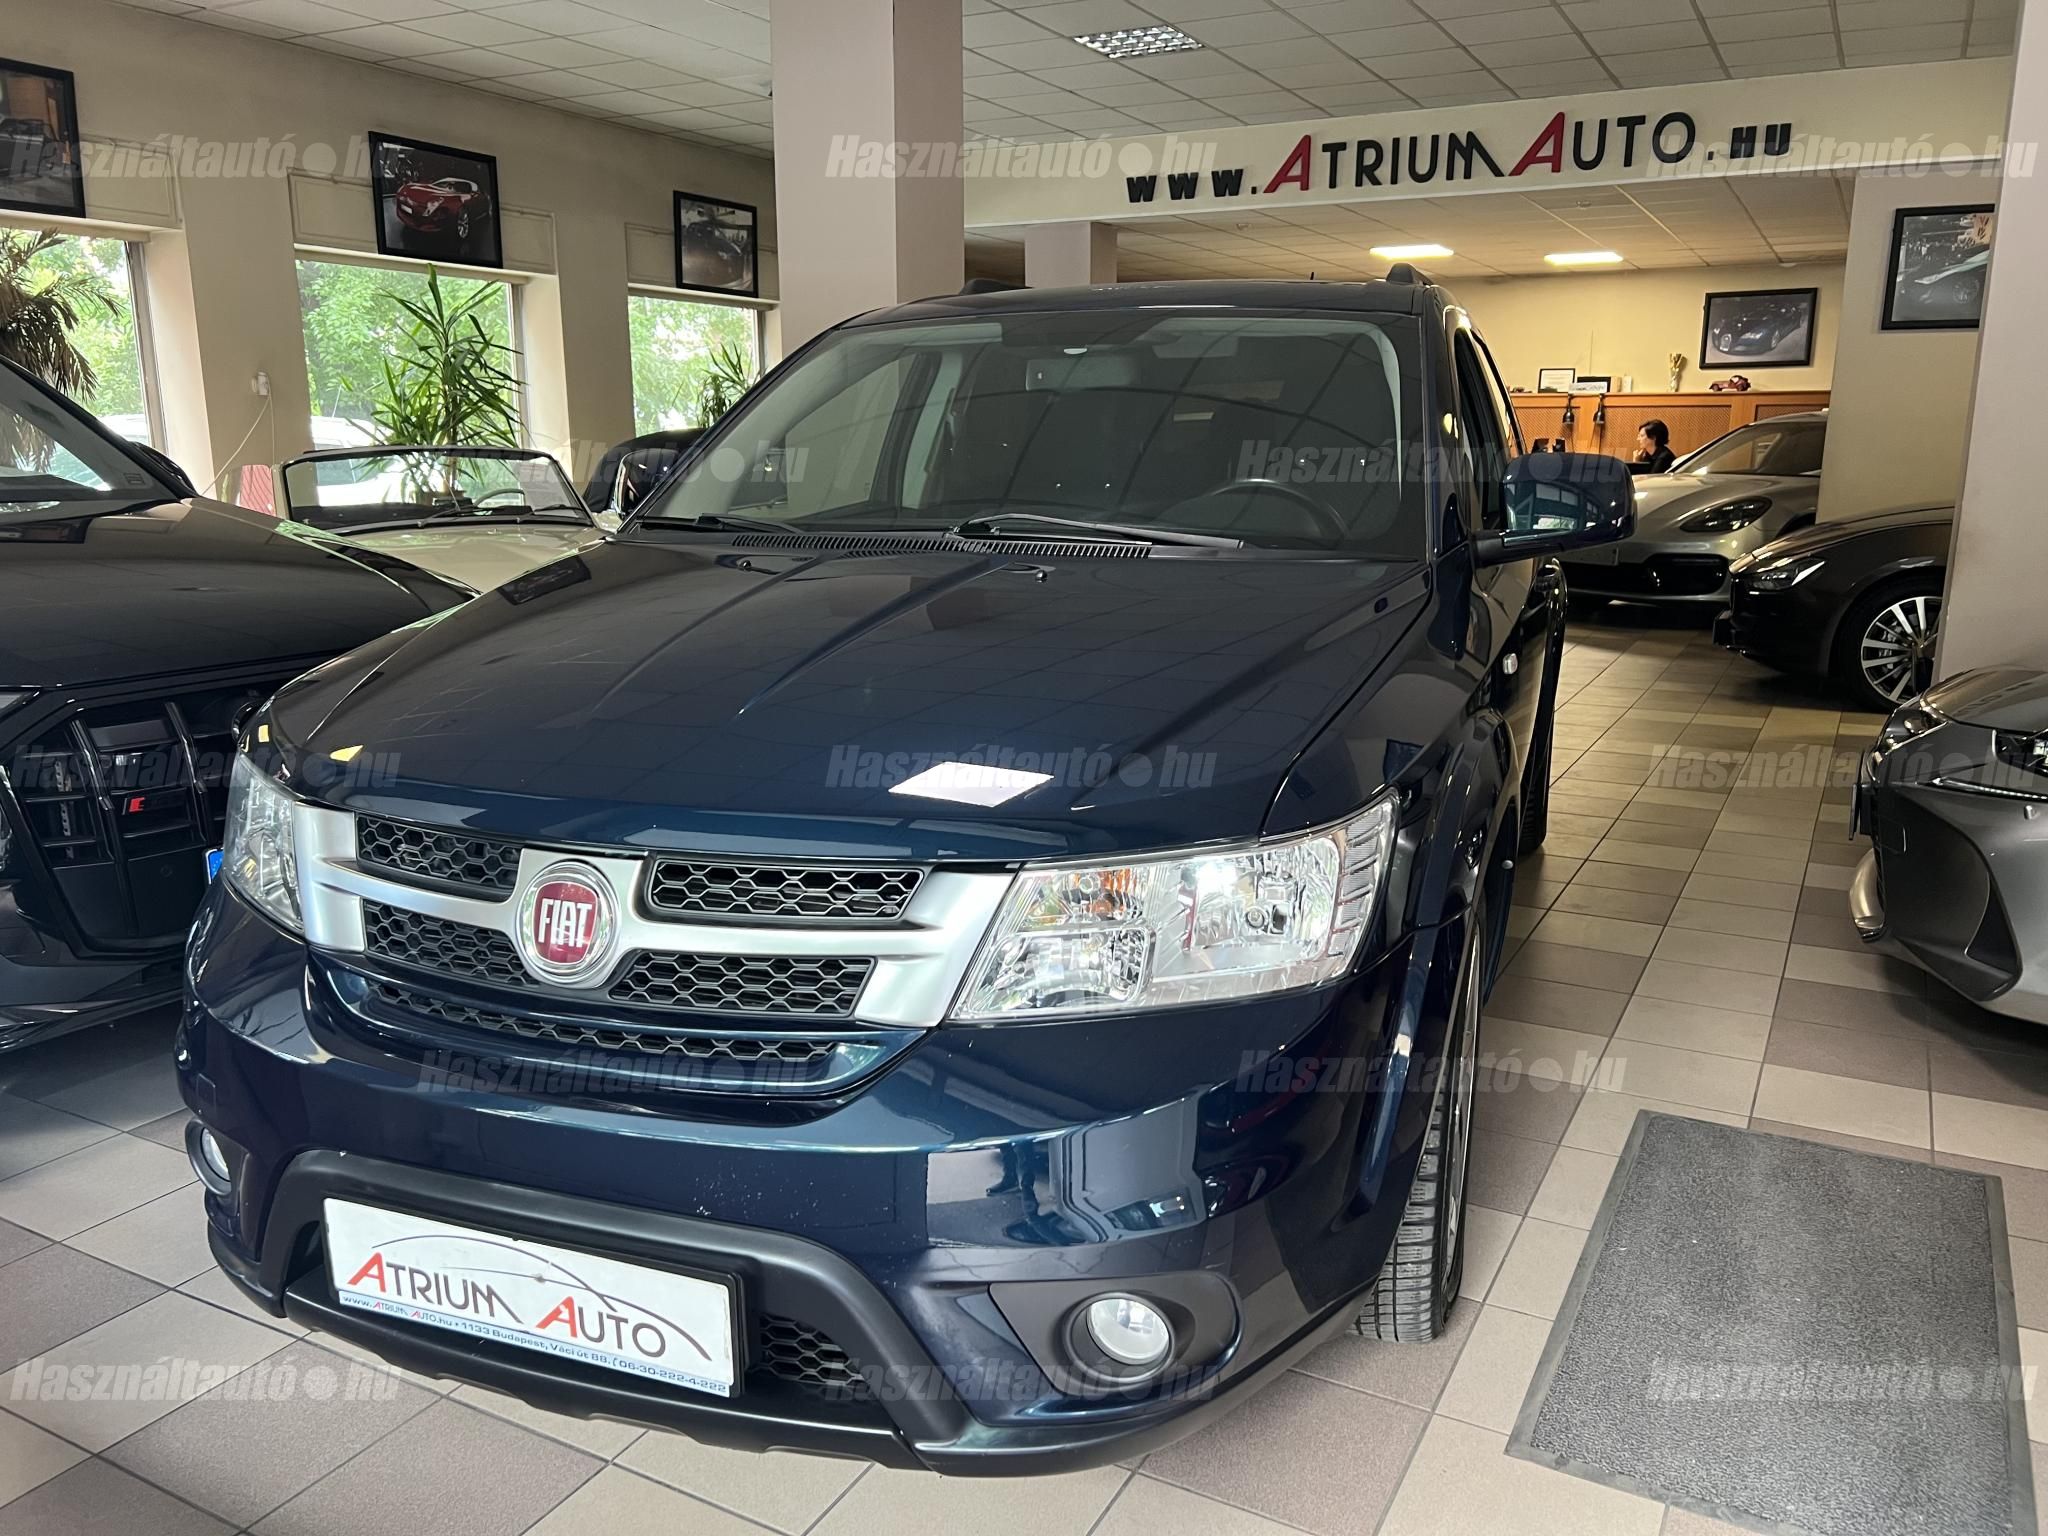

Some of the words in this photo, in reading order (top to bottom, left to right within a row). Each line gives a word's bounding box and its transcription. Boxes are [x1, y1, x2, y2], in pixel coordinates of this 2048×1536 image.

[538, 898, 592, 948] FIAT
[347, 1252, 524, 1325] ATRIUM
[536, 1296, 666, 1358] AUTO
[462, 1321, 490, 1336] 1133
[492, 1328, 548, 1351] Budapest,
